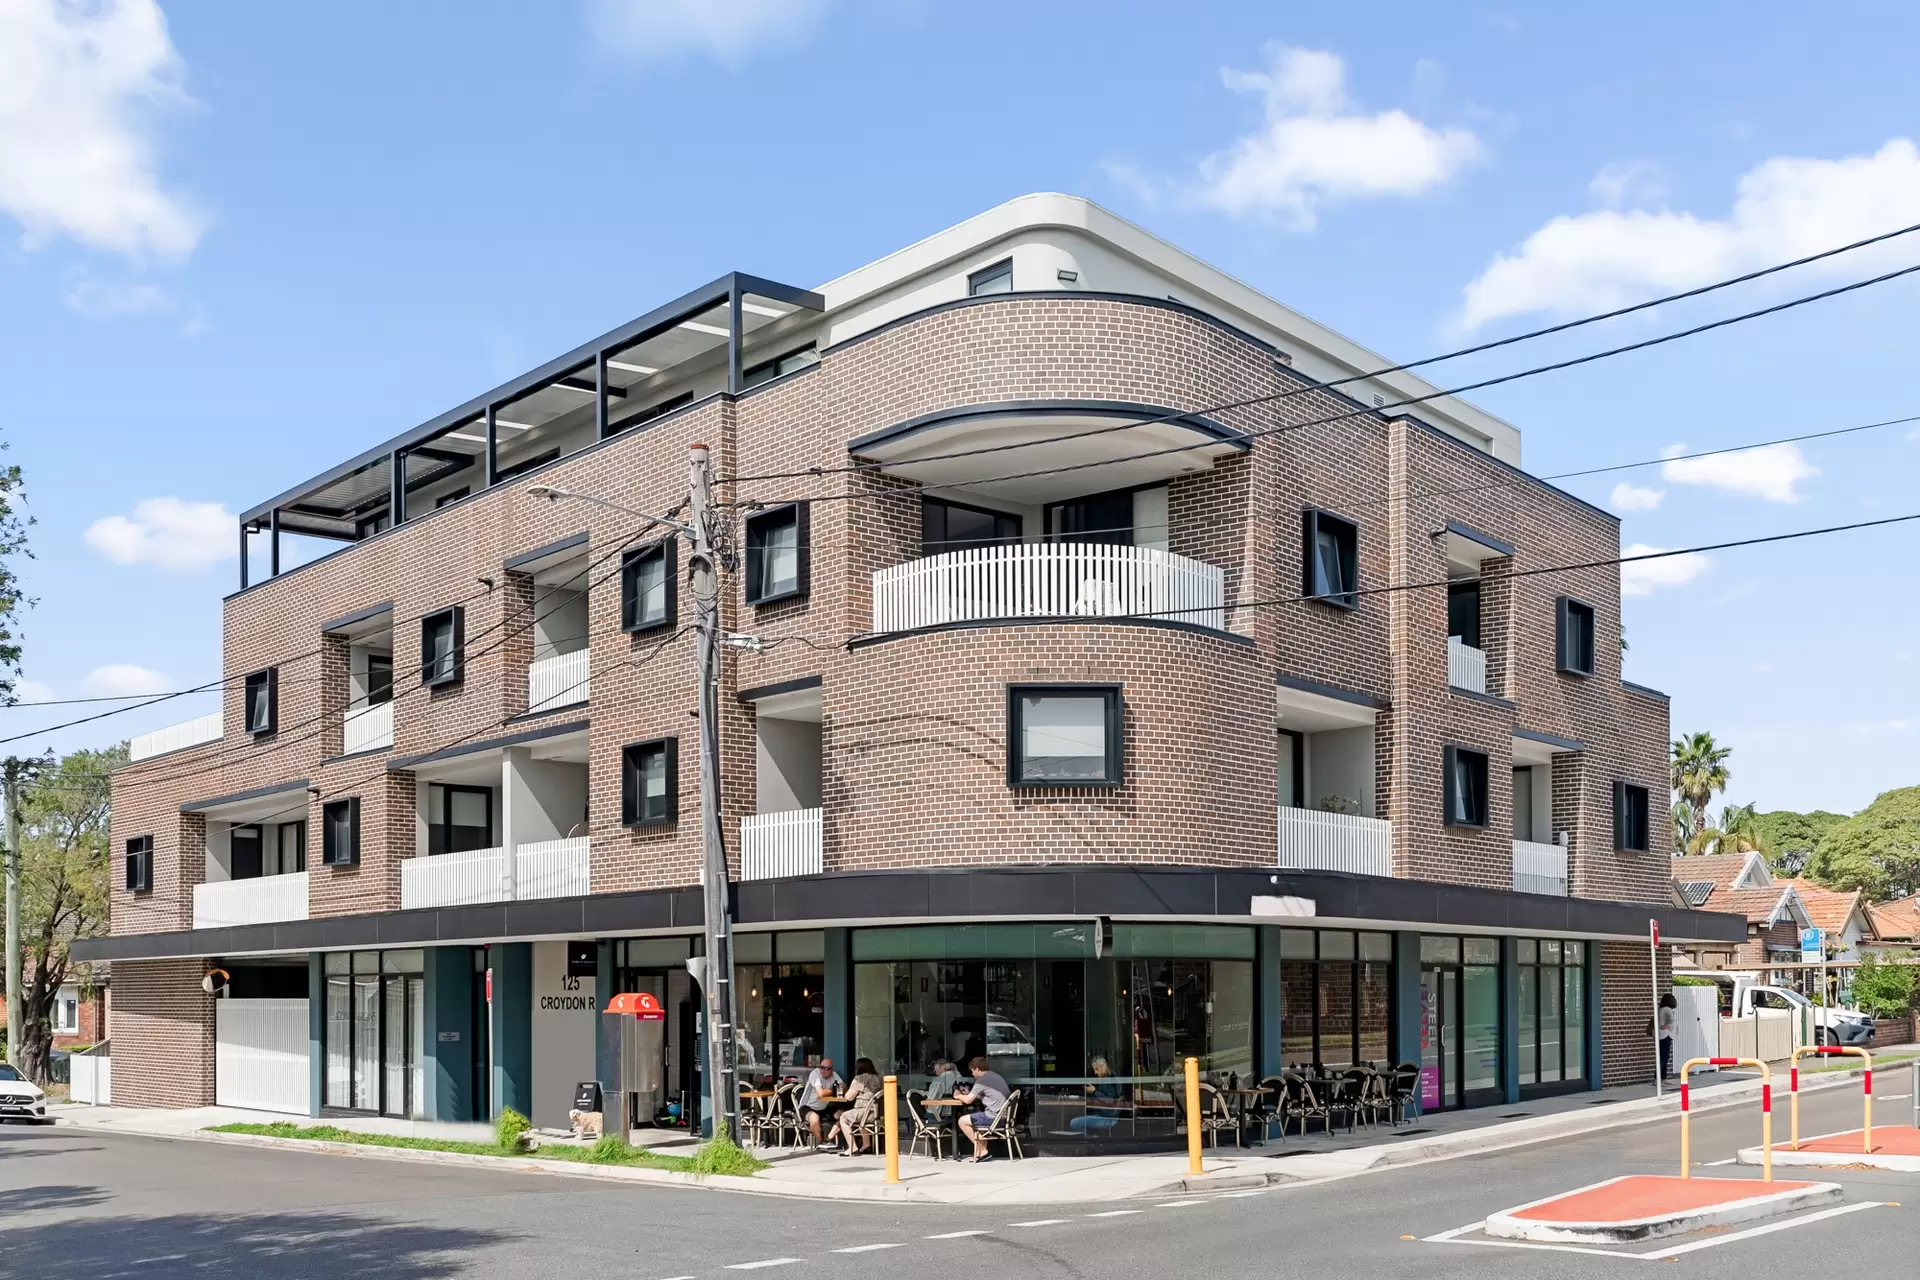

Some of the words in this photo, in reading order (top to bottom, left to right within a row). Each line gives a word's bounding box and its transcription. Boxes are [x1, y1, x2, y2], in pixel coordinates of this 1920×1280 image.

[562, 974, 580, 991] 125
[541, 996, 586, 1010] CROYDON
[589, 996, 596, 1010] R
